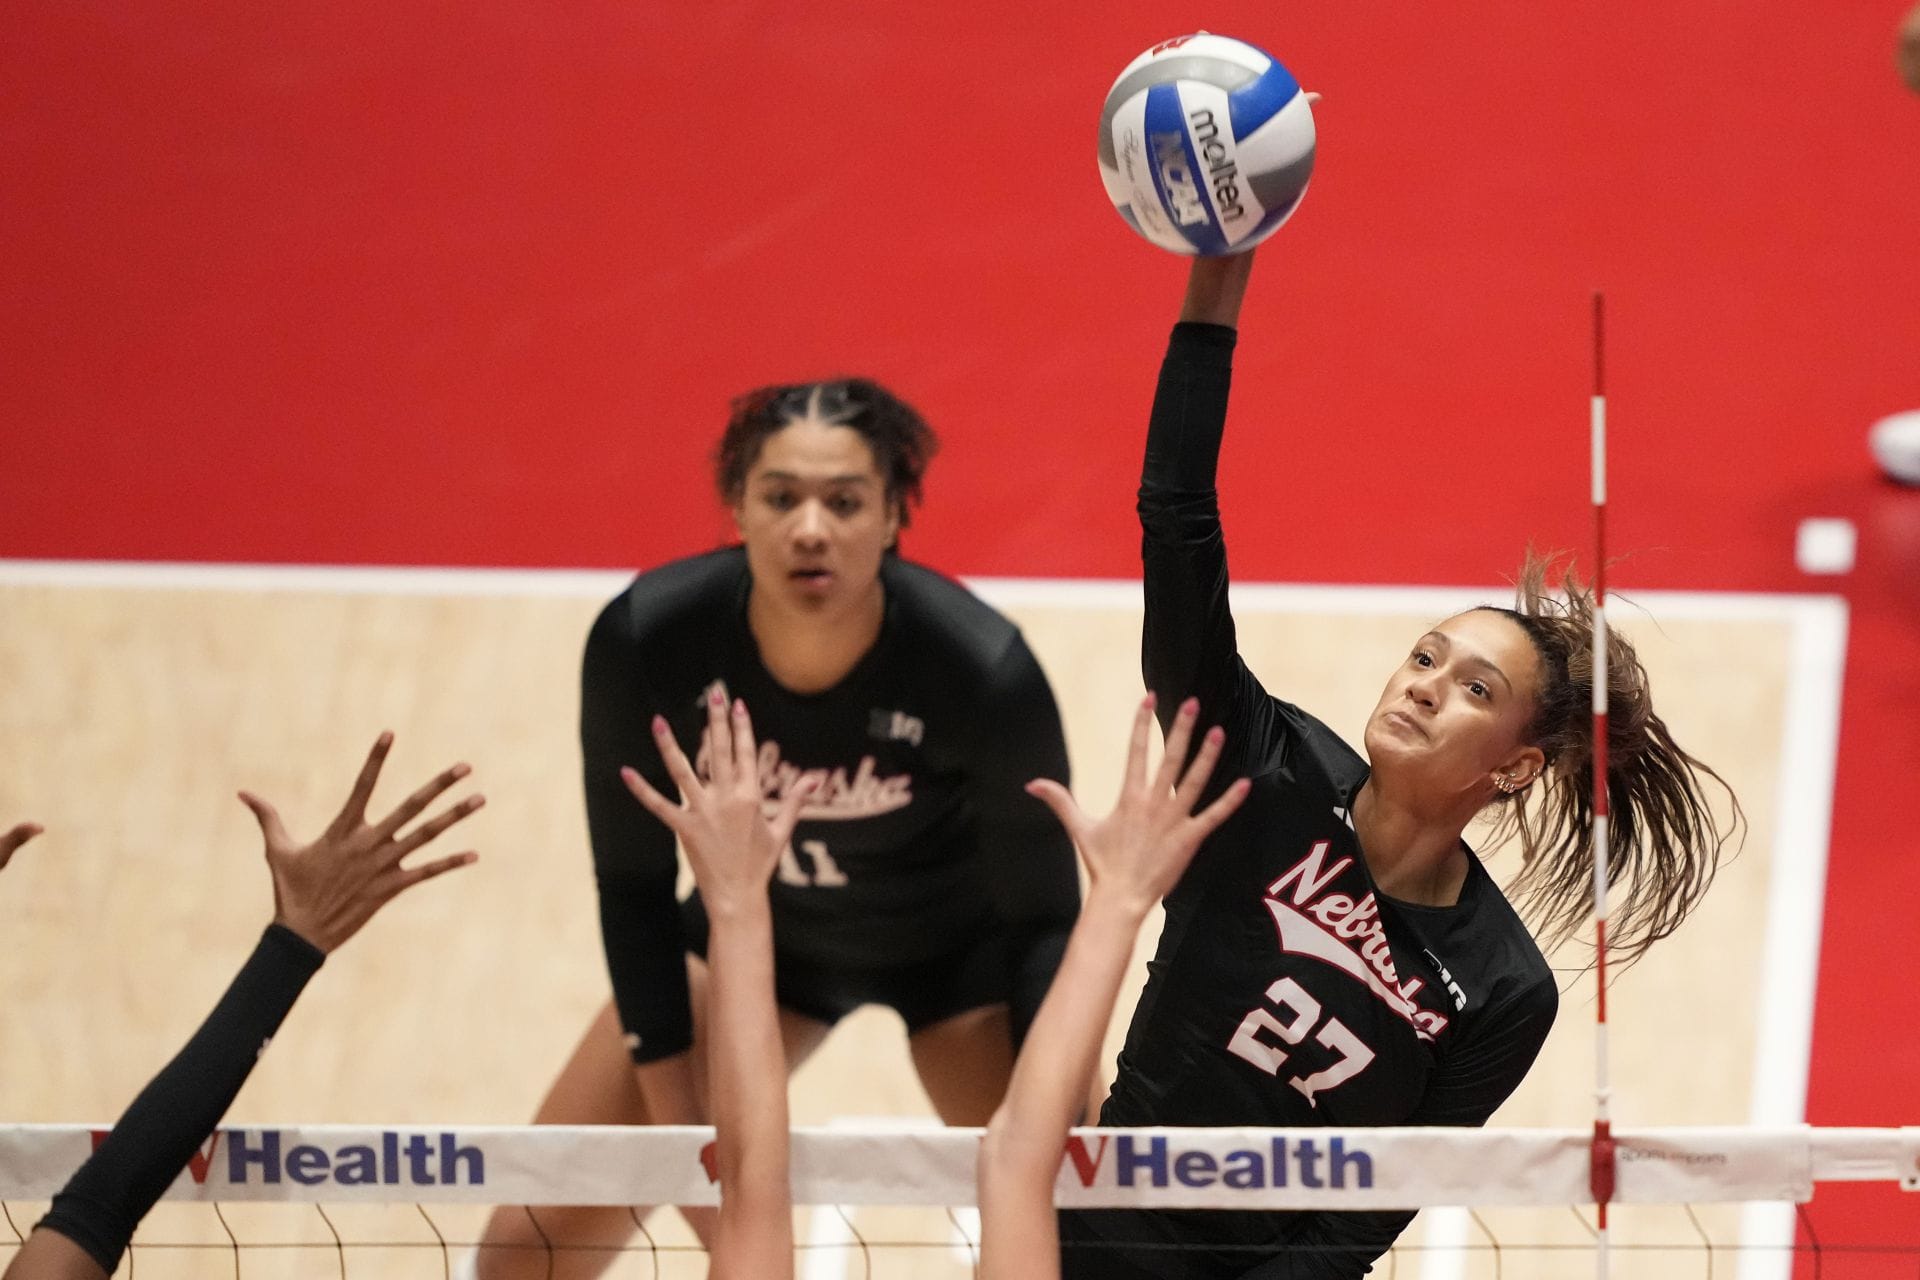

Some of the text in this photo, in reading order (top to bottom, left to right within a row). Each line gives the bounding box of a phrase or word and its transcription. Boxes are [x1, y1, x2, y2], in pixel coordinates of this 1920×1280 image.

[1190, 109, 1244, 223] molten
[1263, 839, 1449, 1038] Nebraka
[1226, 976, 1376, 1109] 27
